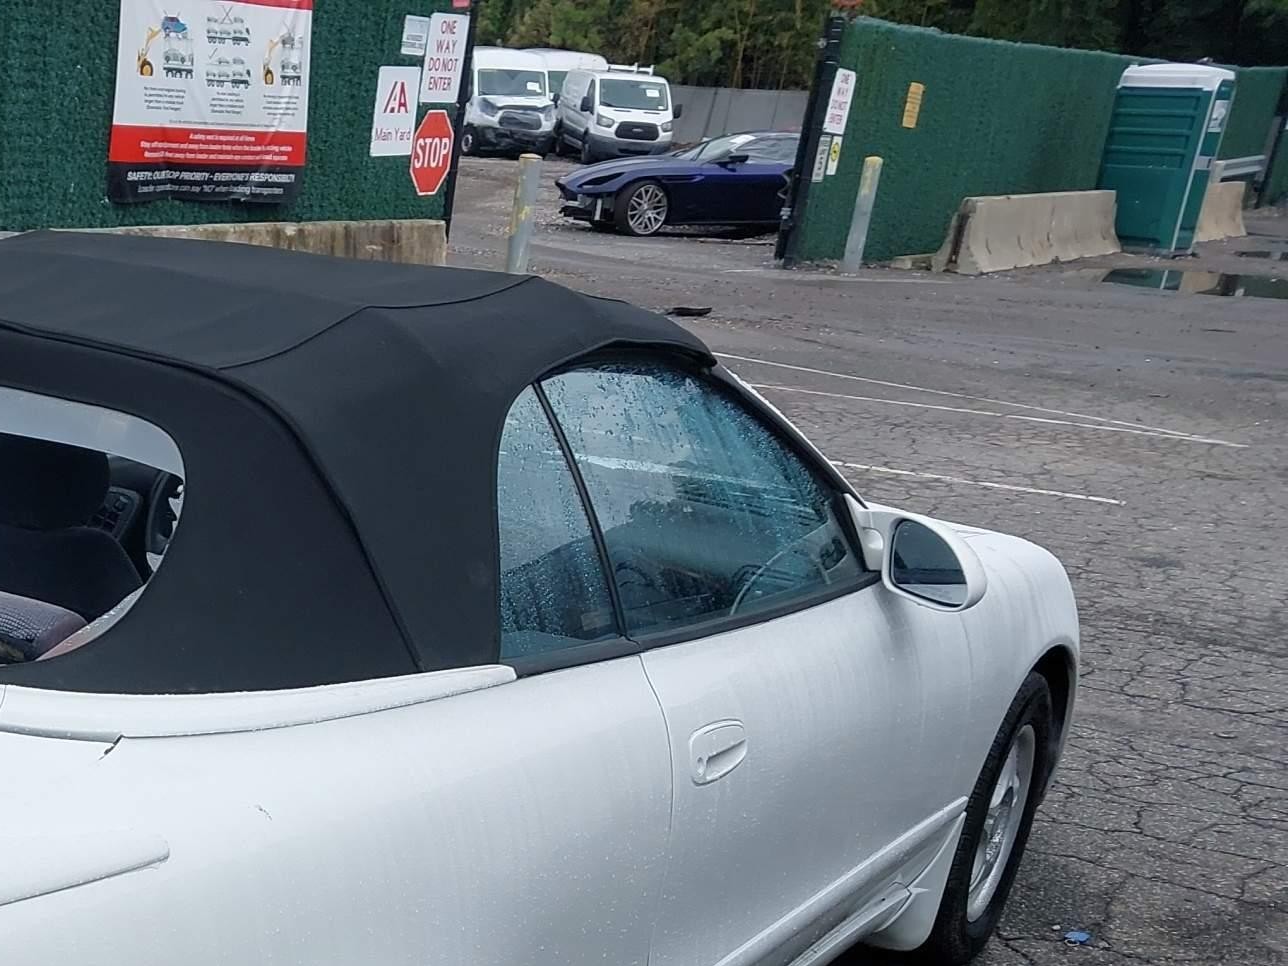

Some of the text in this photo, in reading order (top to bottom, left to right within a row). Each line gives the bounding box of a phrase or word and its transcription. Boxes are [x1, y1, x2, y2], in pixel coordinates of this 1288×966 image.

[440, 20, 457, 34] ONE
[436, 40, 457, 54] WAY
[428, 57, 458, 72] DO NOT
[428, 76, 452, 91] ENTER
[375, 128, 411, 142] Main Yard
[414, 137, 450, 169] STOP
